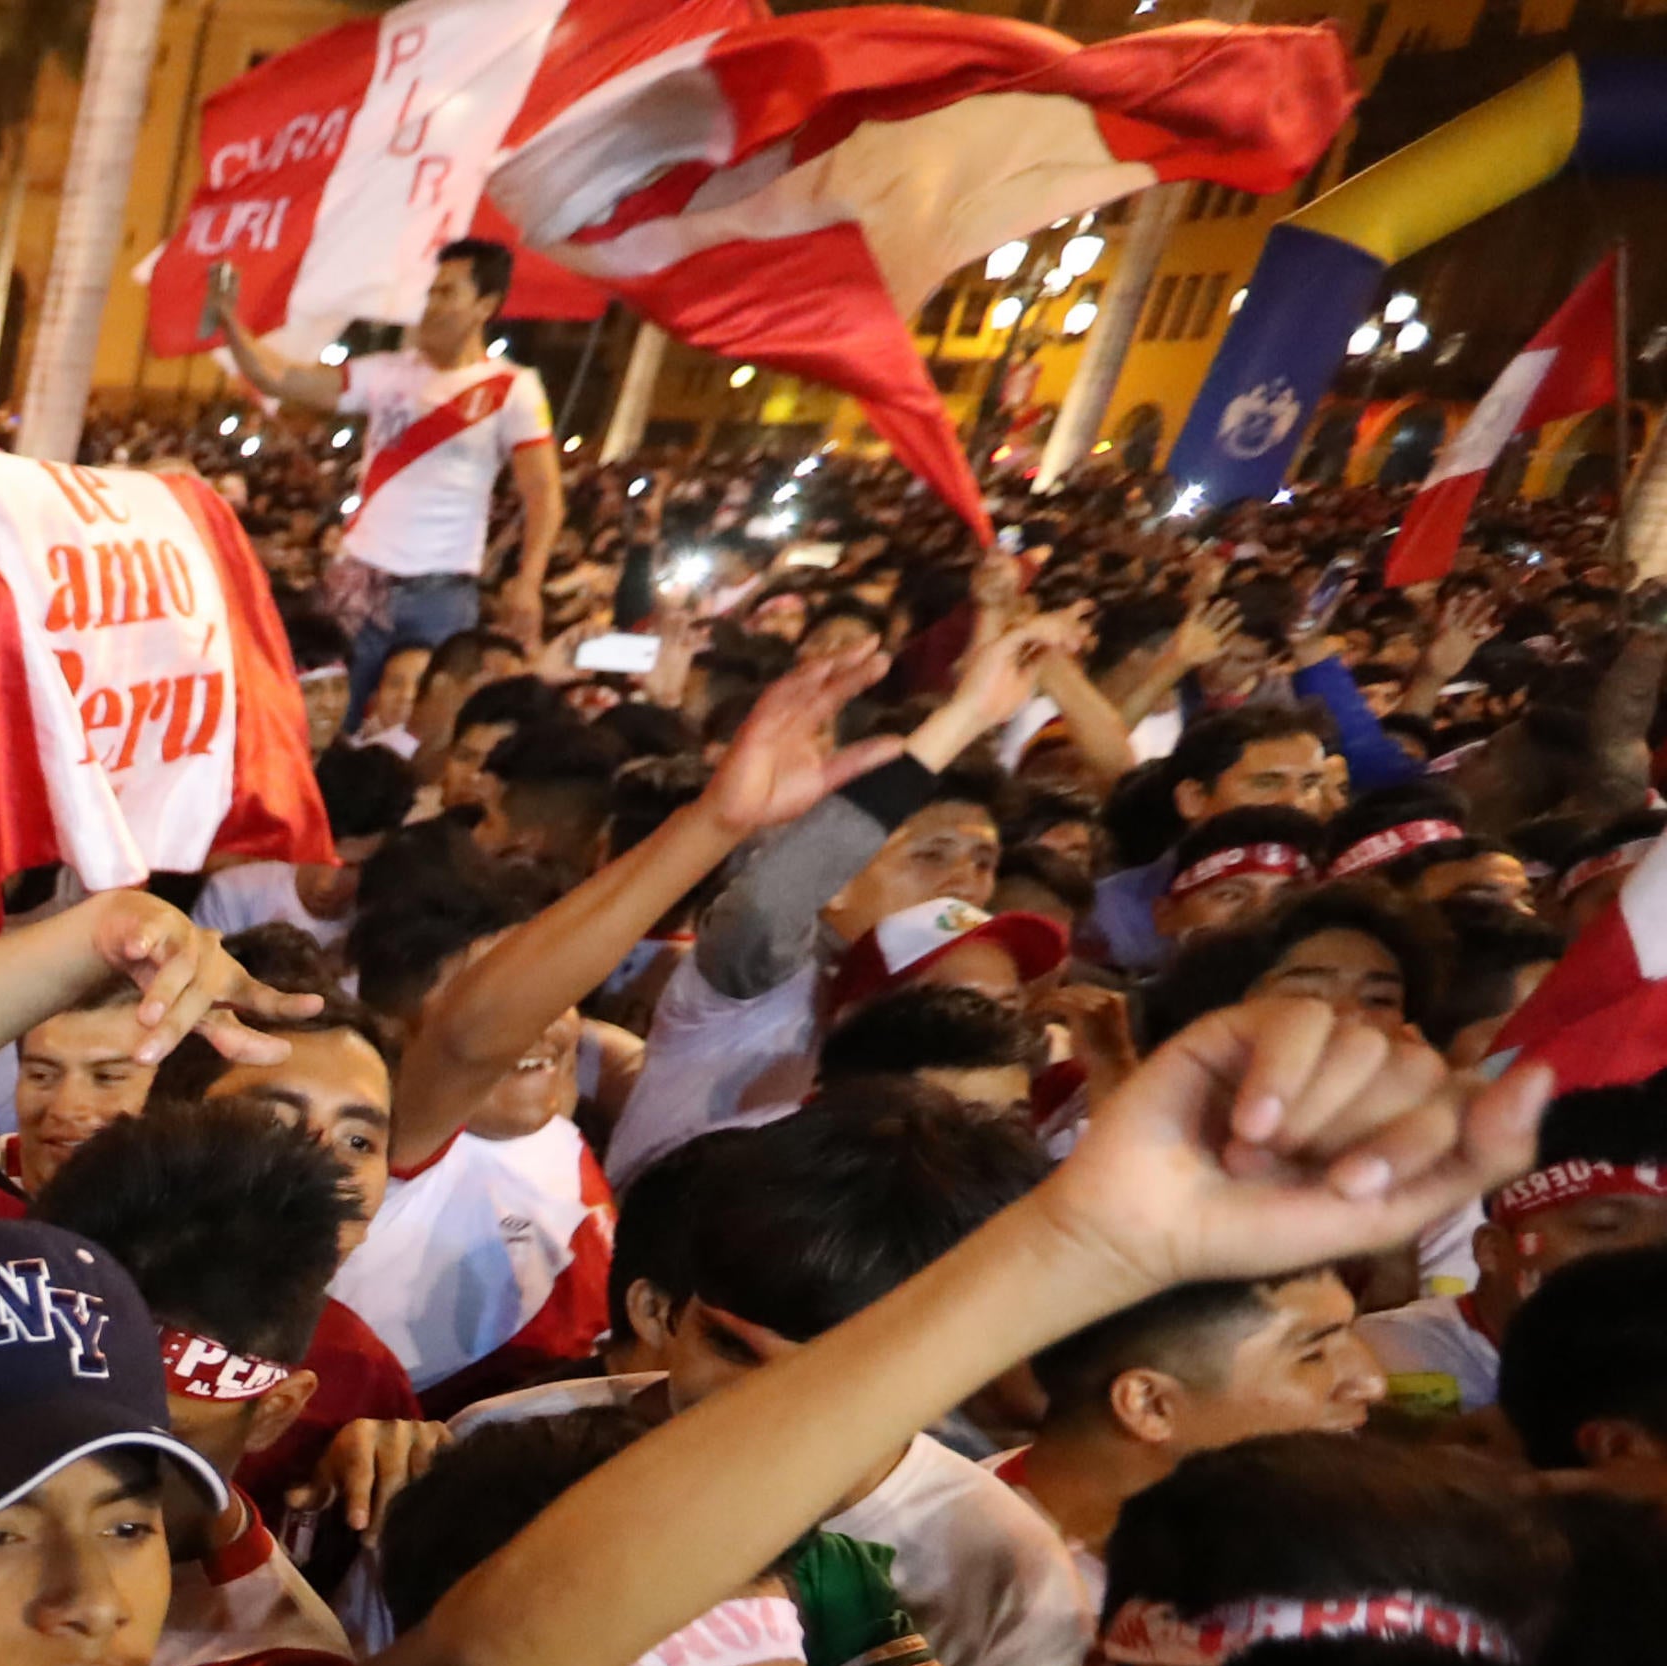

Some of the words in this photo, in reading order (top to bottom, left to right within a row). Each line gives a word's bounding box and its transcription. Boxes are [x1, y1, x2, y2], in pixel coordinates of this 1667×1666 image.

[210, 105, 349, 190] CURA
[38, 460, 130, 525] te
[45, 539, 196, 633] amo
